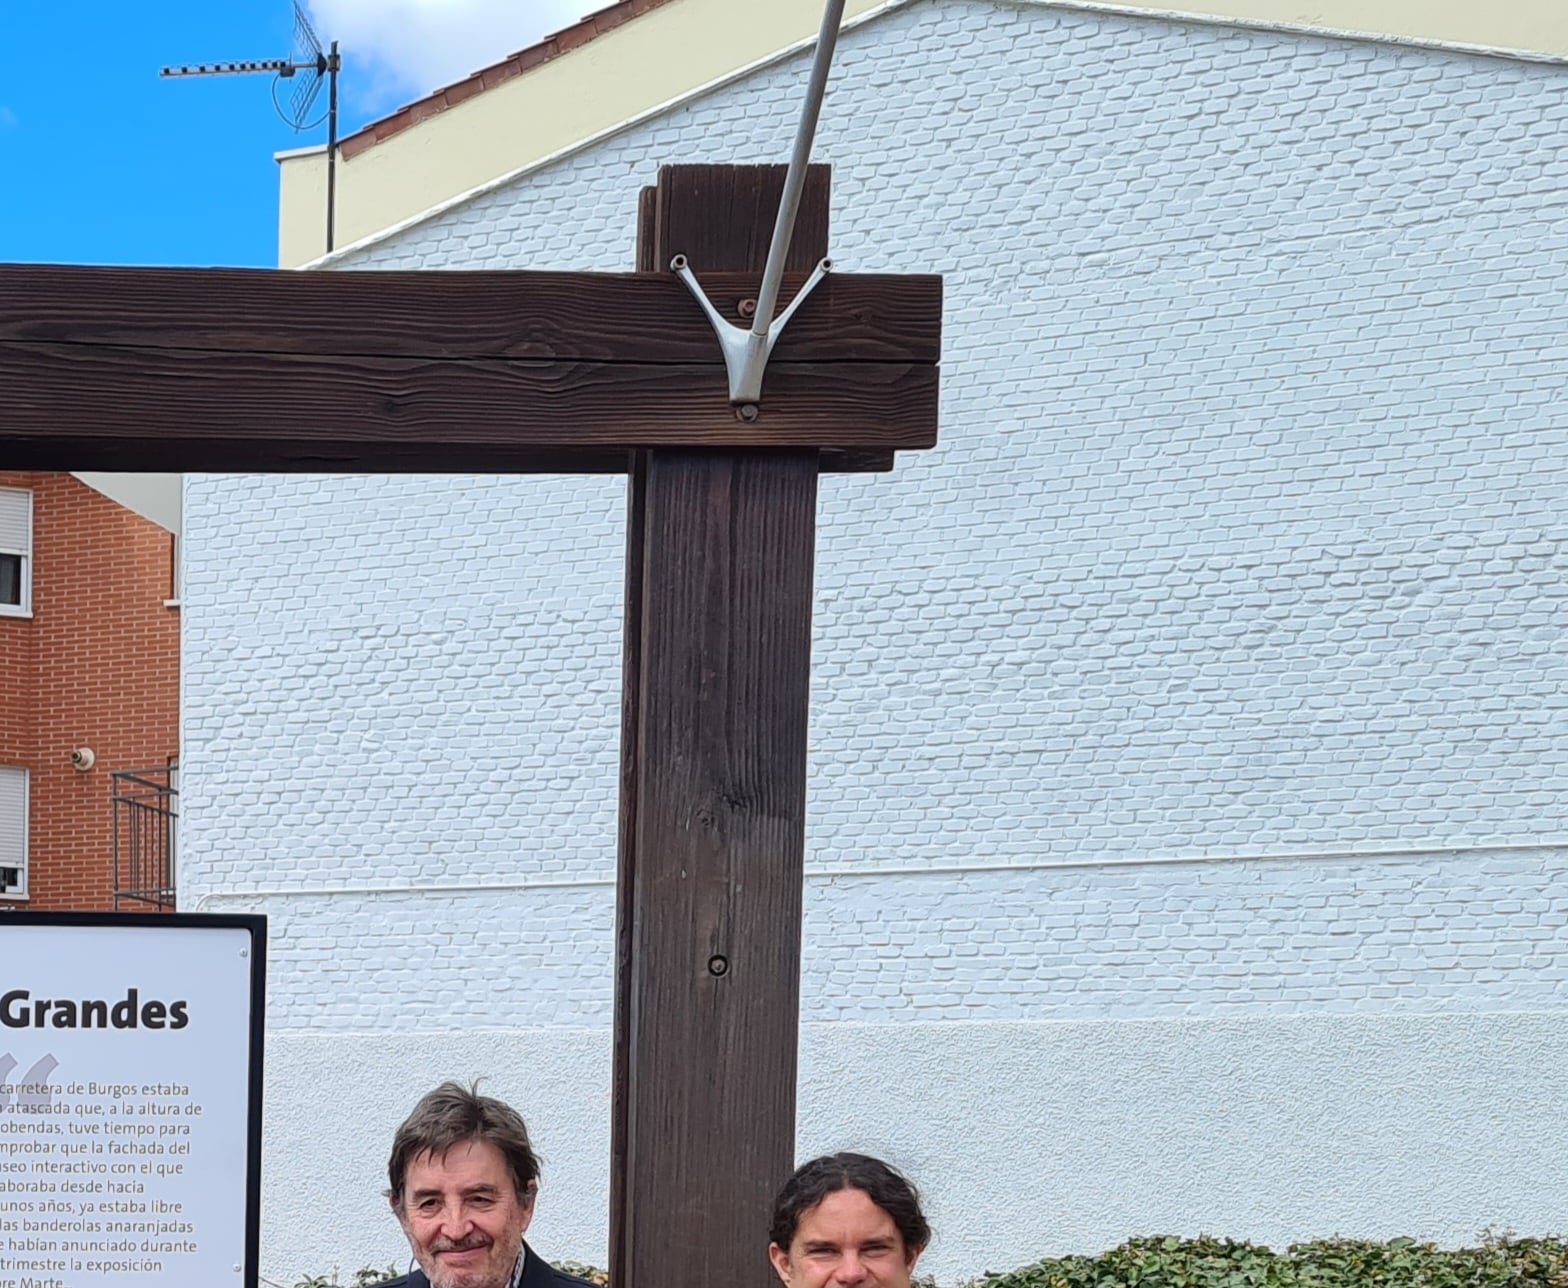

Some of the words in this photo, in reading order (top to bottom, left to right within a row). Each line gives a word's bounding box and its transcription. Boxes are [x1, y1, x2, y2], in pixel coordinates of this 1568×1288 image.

[0, 1080, 62, 1096] carretera
[67, 1081, 84, 1095] de
[89, 1082, 137, 1098] Burgos
[141, 1082, 189, 1095] estaba
[7, 1100, 70, 1114] atascada
[75, 1104, 105, 1117] que,
[109, 1105, 117, 1115] a
[122, 1100, 134, 1115] la
[138, 1101, 180, 1115] altura
[184, 1102, 202, 1115] de
[68, 1121, 100, 1134] tuve
[104, 1121, 155, 1138] tiempo
[159, 1125, 190, 1138] para
[60, 1144, 87, 1157] que
[92, 1140, 103, 1154] la
[108, 1140, 164, 1154] fachada
[169, 1141, 190, 1154] del
[31, 1160, 107, 1173] interactivo
[111, 1164, 136, 1174] con
[140, 1160, 152, 1174] el
[156, 1164, 183, 1177] que
[61, 1179, 103, 1193] desde
[39, 1199, 75, 1214] años,
[79, 1203, 94, 1216] ya
[99, 1199, 146, 1213] estaba
[151, 1199, 182, 1213] libre
[0, 1218, 18, 1231] las
[23, 1218, 101, 1232] banderolas
[106, 1219, 193, 1235] anaranjadas
[9, 1237, 57, 1251] habían
[61, 1238, 137, 1252] anunciado
[140, 1239, 197, 1252] durante
[0, 1257, 66, 1271] trimestre
[70, 1257, 82, 1271] la
[86, 1258, 162, 1274] exposición
